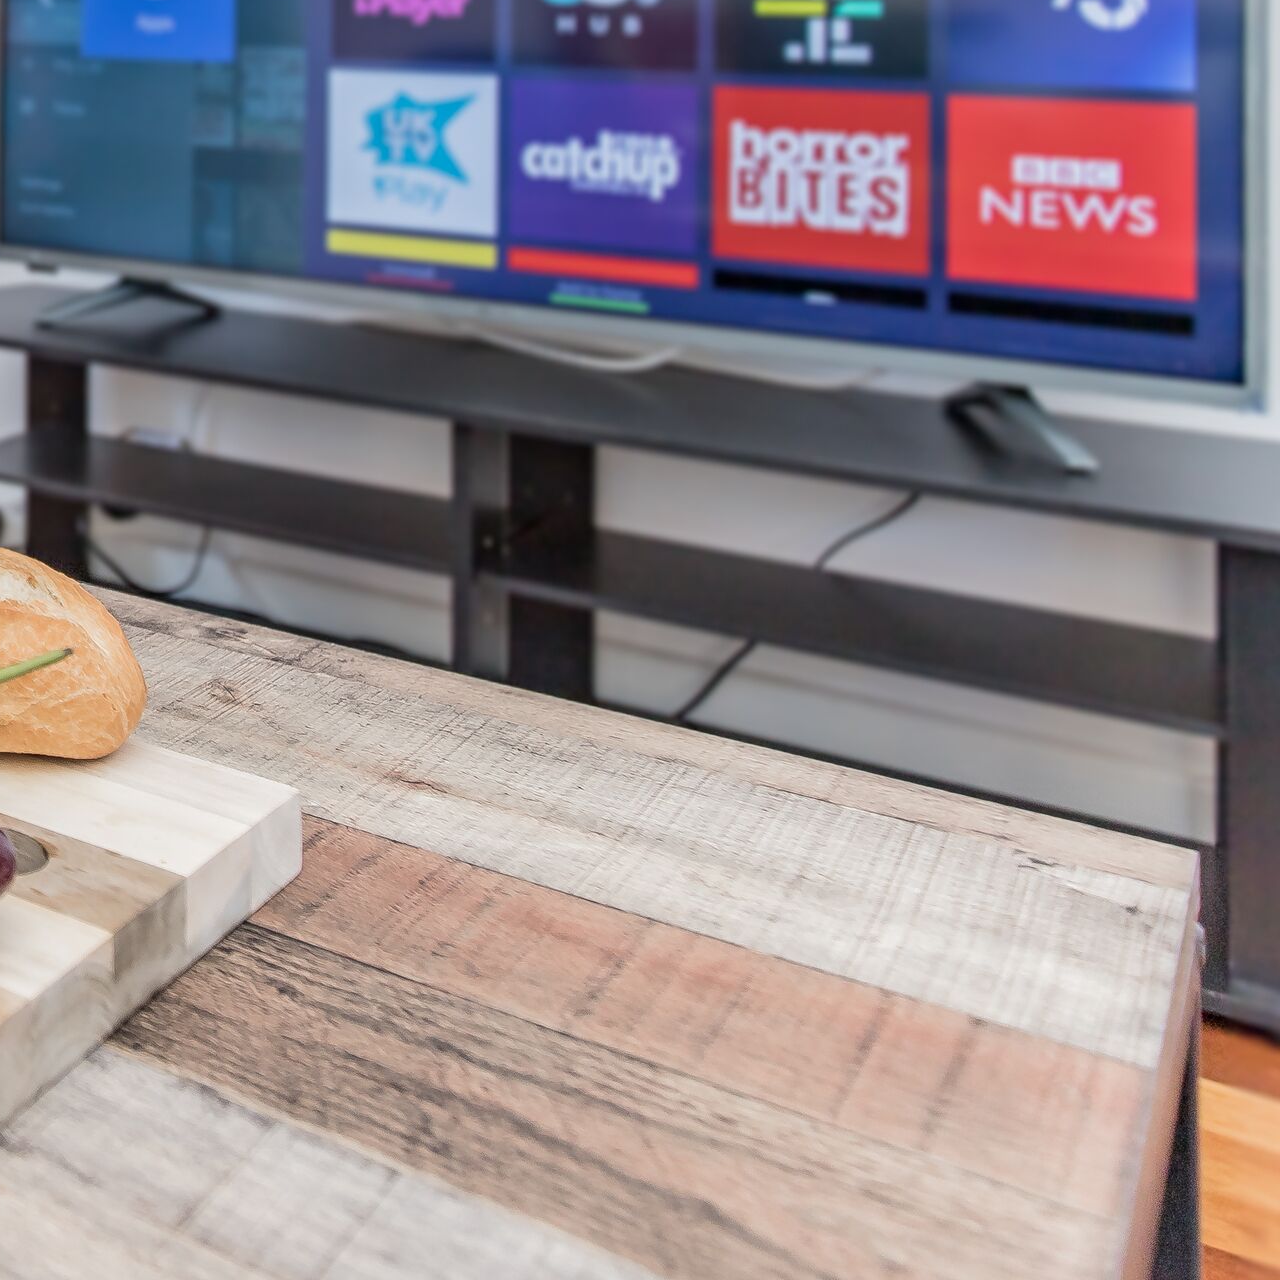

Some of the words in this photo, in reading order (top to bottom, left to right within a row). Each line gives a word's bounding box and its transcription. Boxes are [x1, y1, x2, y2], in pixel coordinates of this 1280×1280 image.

[522, 130, 680, 201] catchup
[730, 119, 909, 166] horror
[735, 167, 902, 224] BITES
[979, 185, 1159, 238] NEWS
